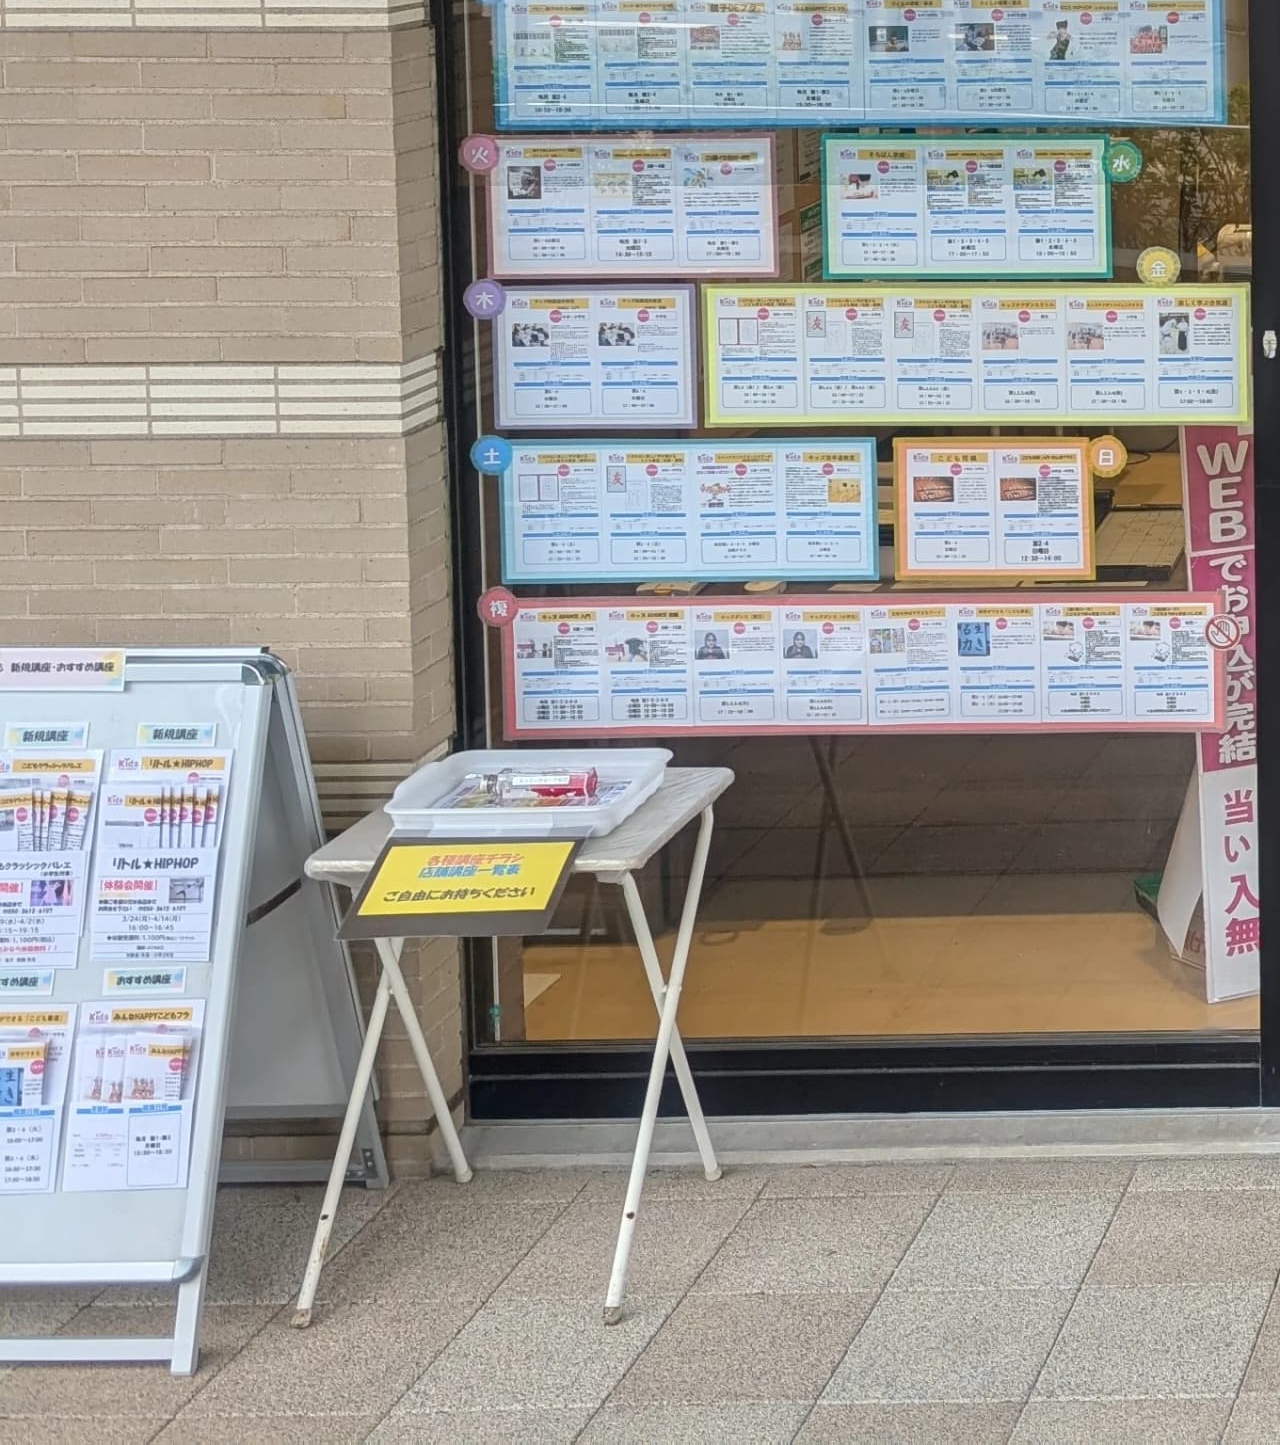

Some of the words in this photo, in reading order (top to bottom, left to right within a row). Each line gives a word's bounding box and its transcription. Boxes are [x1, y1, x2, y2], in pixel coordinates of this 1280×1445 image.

[471, 147, 490, 165] 火
[1112, 153, 1131, 172] 水
[476, 291, 495, 309] 木
[483, 448, 502, 466] 土
[23, 729, 69, 742] 新規講座
[152, 727, 198, 740] 新規講座
[118, 757, 138, 768] Kids
[383, 885, 536, 903] ご自由にお持ちください
[116, 973, 172, 986] おすすめ講座
